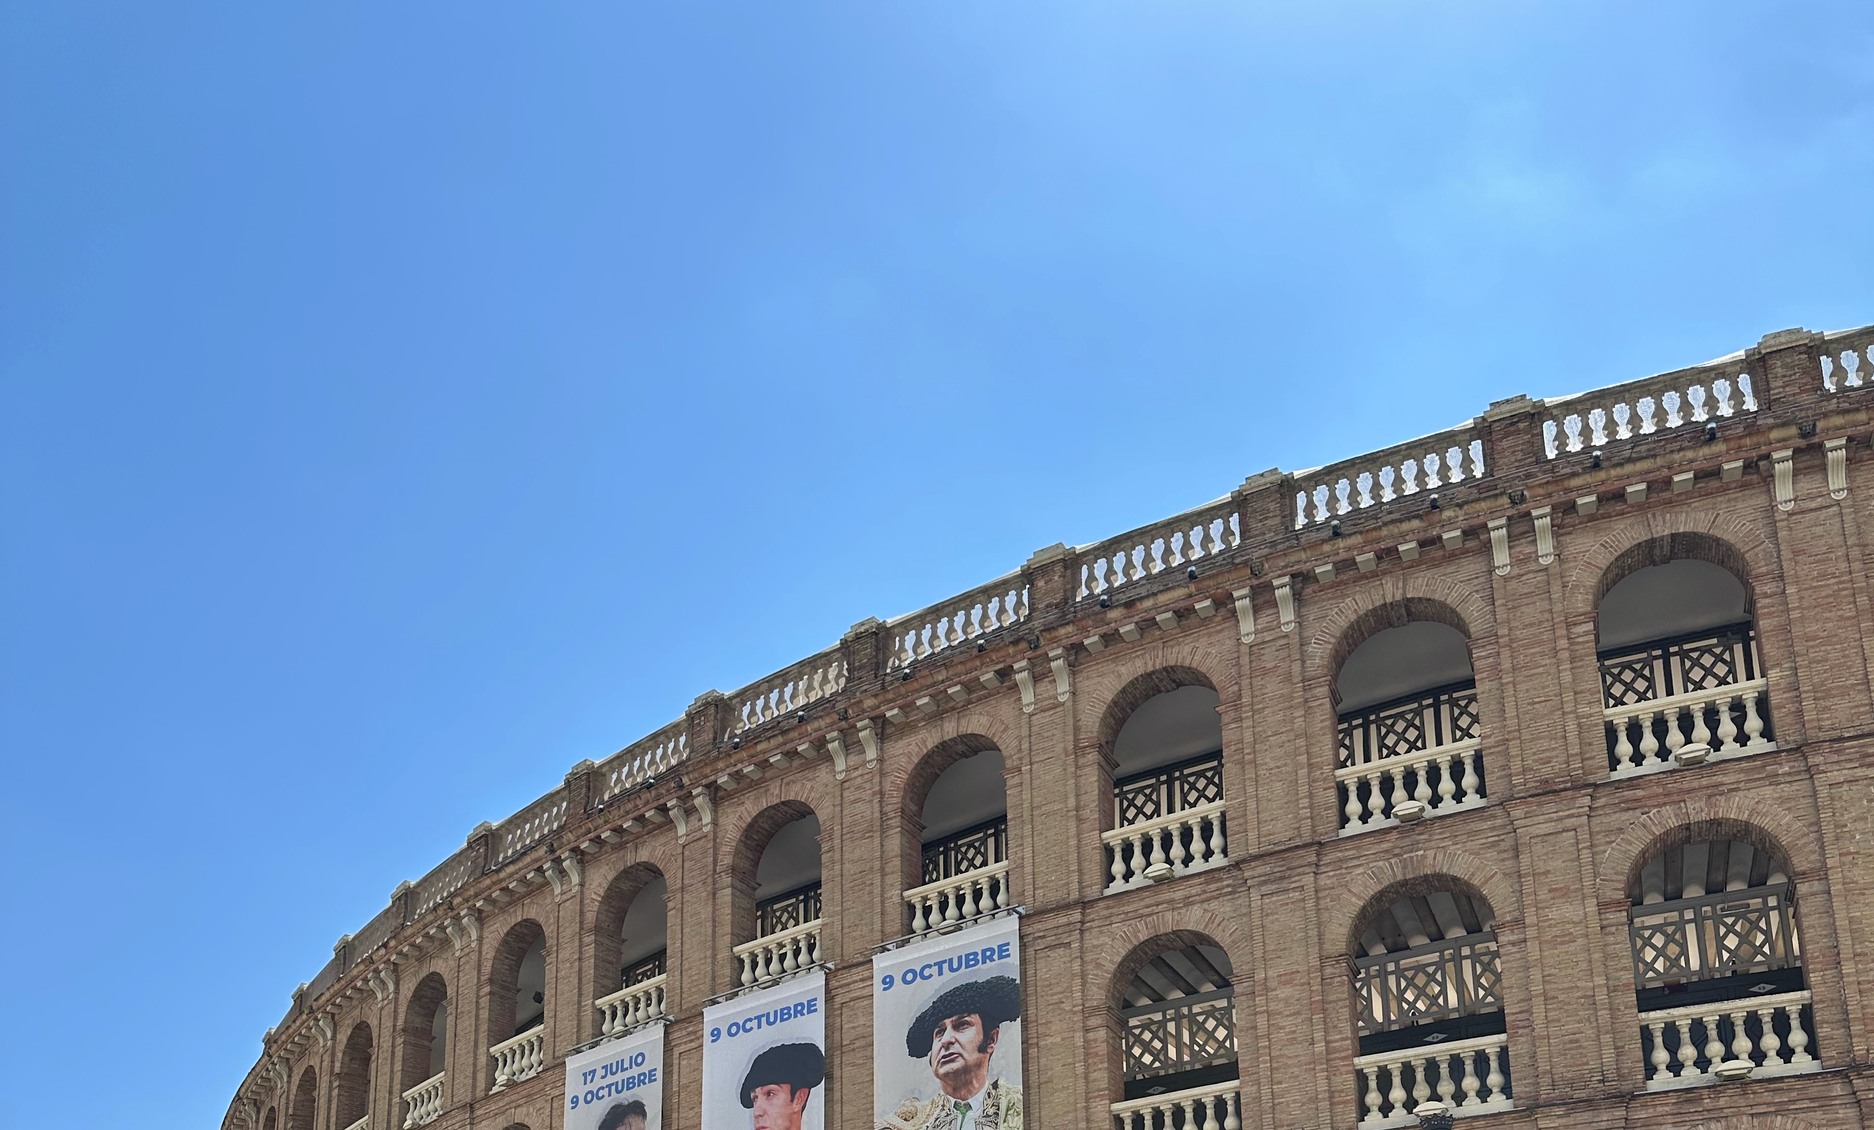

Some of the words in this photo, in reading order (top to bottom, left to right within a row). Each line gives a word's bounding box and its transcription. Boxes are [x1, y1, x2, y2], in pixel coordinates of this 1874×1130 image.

[881, 974, 895, 991] 9
[901, 941, 1011, 985] OCTUBRE
[710, 1027, 722, 1043] 9
[727, 997, 818, 1037] OCTUBRE
[570, 1095, 580, 1110] 9
[583, 1067, 658, 1105] OCTUBRE
[582, 1068, 597, 1086] 17
[600, 1052, 646, 1080] JULIO
